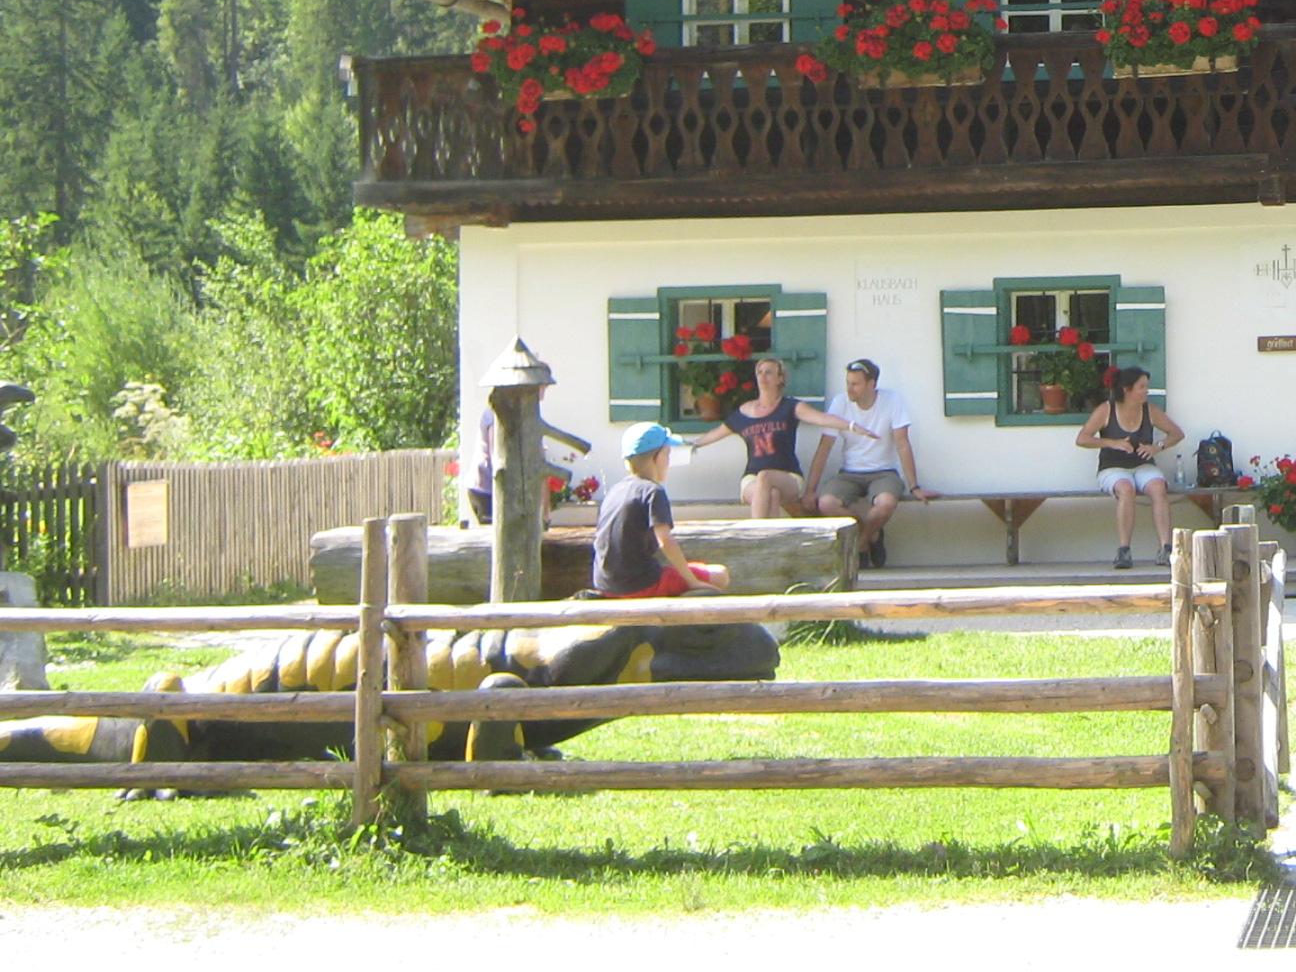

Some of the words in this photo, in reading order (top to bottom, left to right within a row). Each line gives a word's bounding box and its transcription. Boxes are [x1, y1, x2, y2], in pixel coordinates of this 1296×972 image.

[856, 277, 918, 291] KLAUSBACH
[872, 293, 902, 306] HAUS
[754, 432, 776, 458] N
